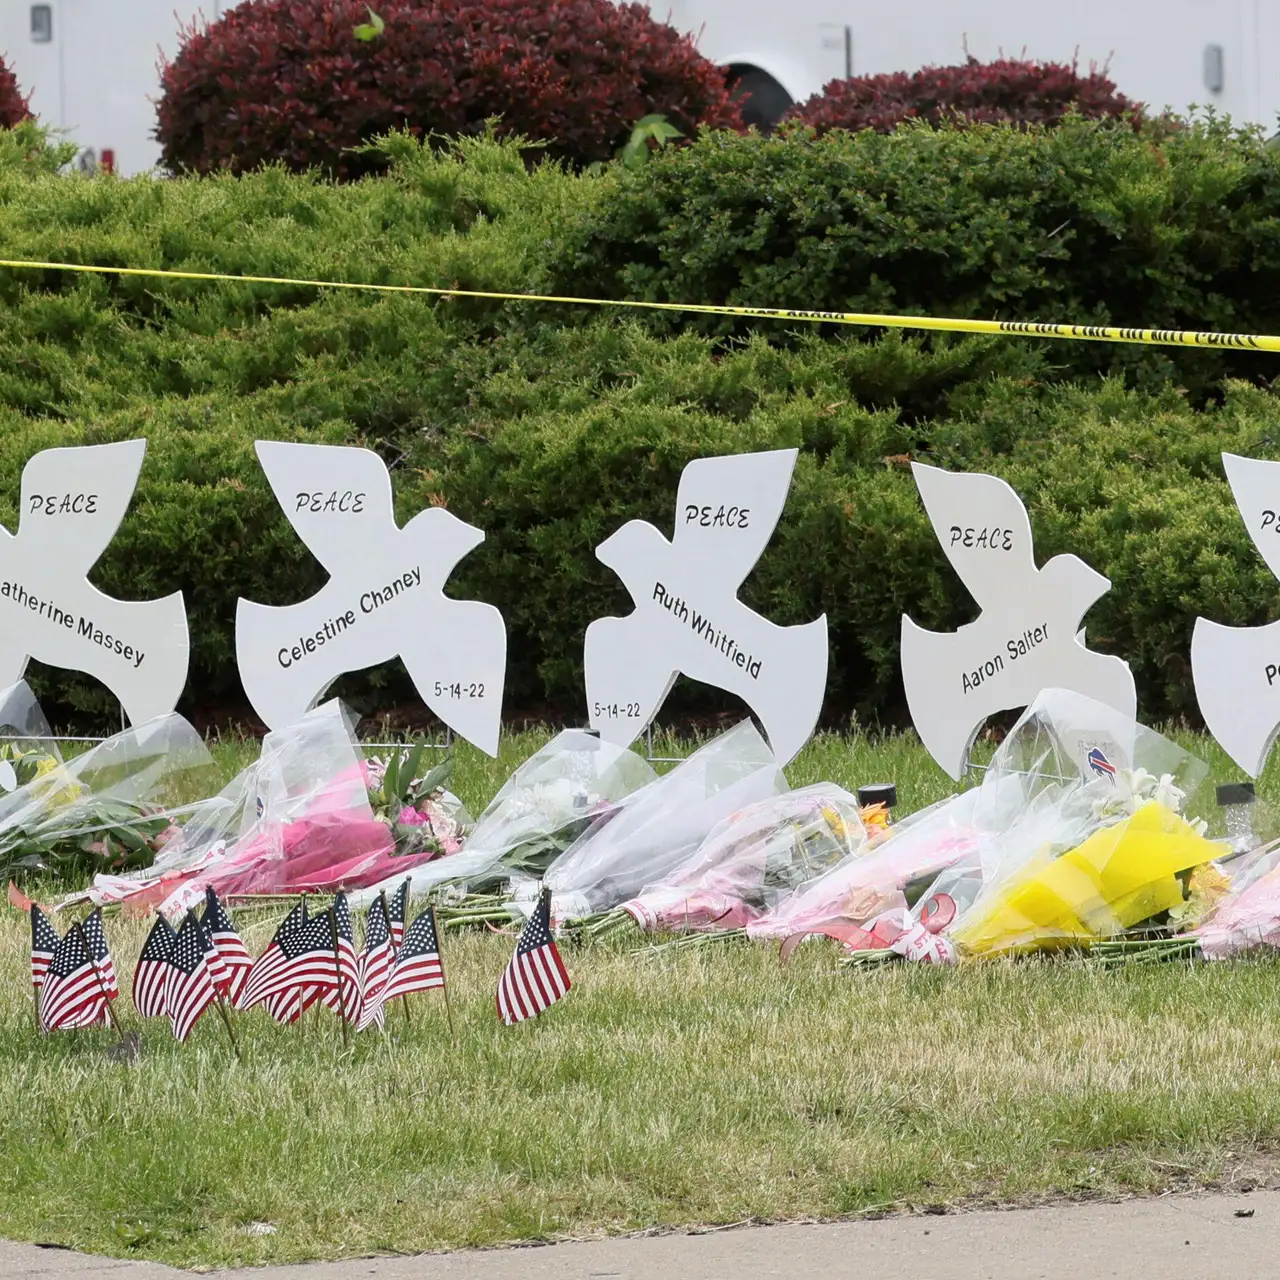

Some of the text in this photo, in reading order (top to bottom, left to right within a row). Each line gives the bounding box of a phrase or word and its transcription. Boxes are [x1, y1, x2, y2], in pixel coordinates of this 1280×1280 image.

[29, 493, 98, 516] PEACE
[295, 490, 366, 513] PEACE
[685, 504, 750, 529] PEACE
[950, 525, 1013, 551] PEACE
[277, 566, 421, 669] Celestine Chaney
[77, 616, 145, 668] Massey
[652, 581, 763, 680] Ruth Whitfield
[962, 622, 1048, 695] Aaron Salter
[434, 681, 485, 700] 5-14-22
[594, 702, 641, 718] 5-14-22
